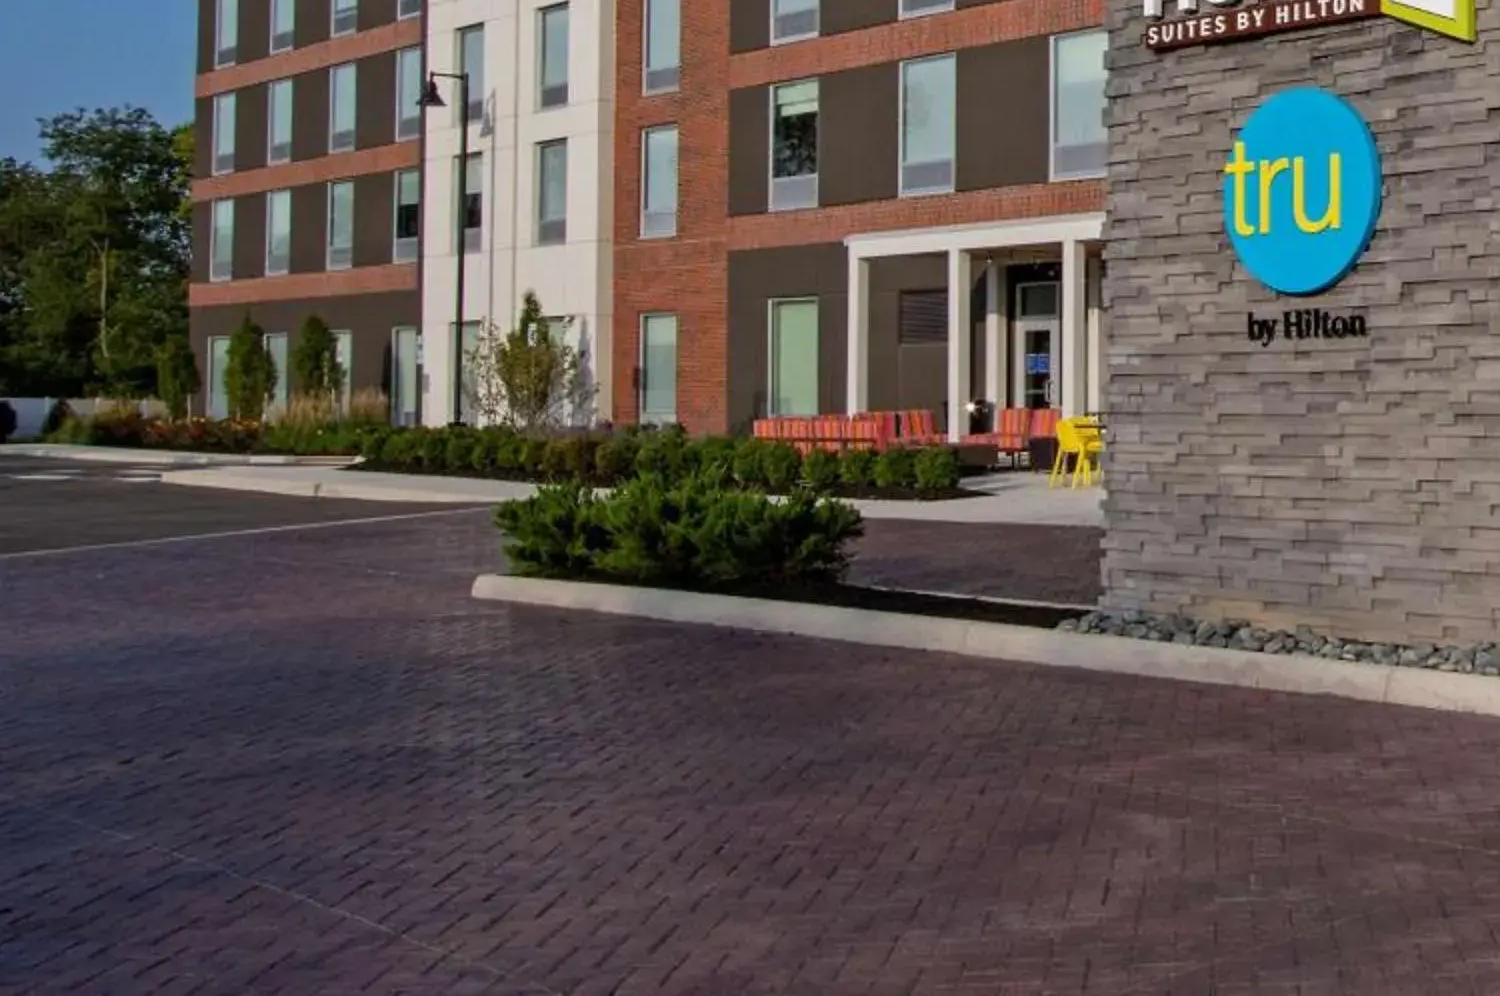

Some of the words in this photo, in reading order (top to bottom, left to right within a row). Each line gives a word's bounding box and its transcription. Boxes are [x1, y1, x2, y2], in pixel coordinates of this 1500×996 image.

[1147, 15, 1227, 45] SUITES
[1237, 9, 1266, 32] BY
[1224, 140, 1342, 237] tru
[1247, 311, 1278, 348] by
[1283, 307, 1368, 340] Hilton
